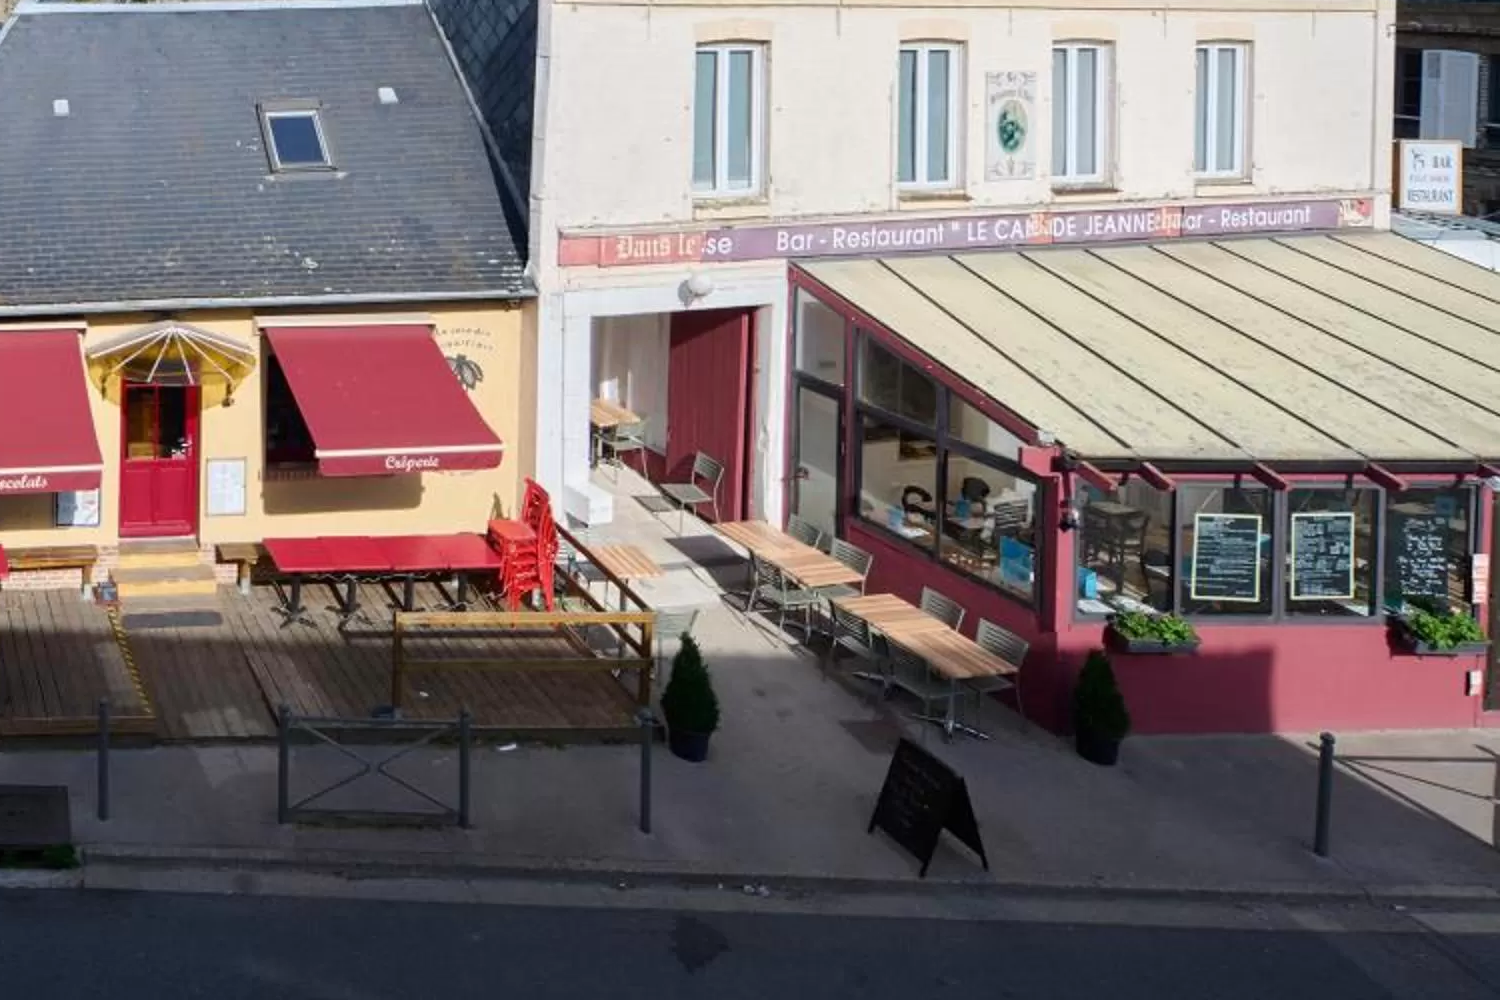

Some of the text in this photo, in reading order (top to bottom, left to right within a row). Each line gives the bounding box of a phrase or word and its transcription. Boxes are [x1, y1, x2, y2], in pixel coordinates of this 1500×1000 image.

[776, 231, 815, 252] Bar
[832, 223, 944, 249] Restaurant
[966, 220, 989, 242] LE
[1053, 216, 1078, 237] DE
[1084, 211, 1157, 236] JEANNE
[1220, 205, 1311, 229] Restaurant
